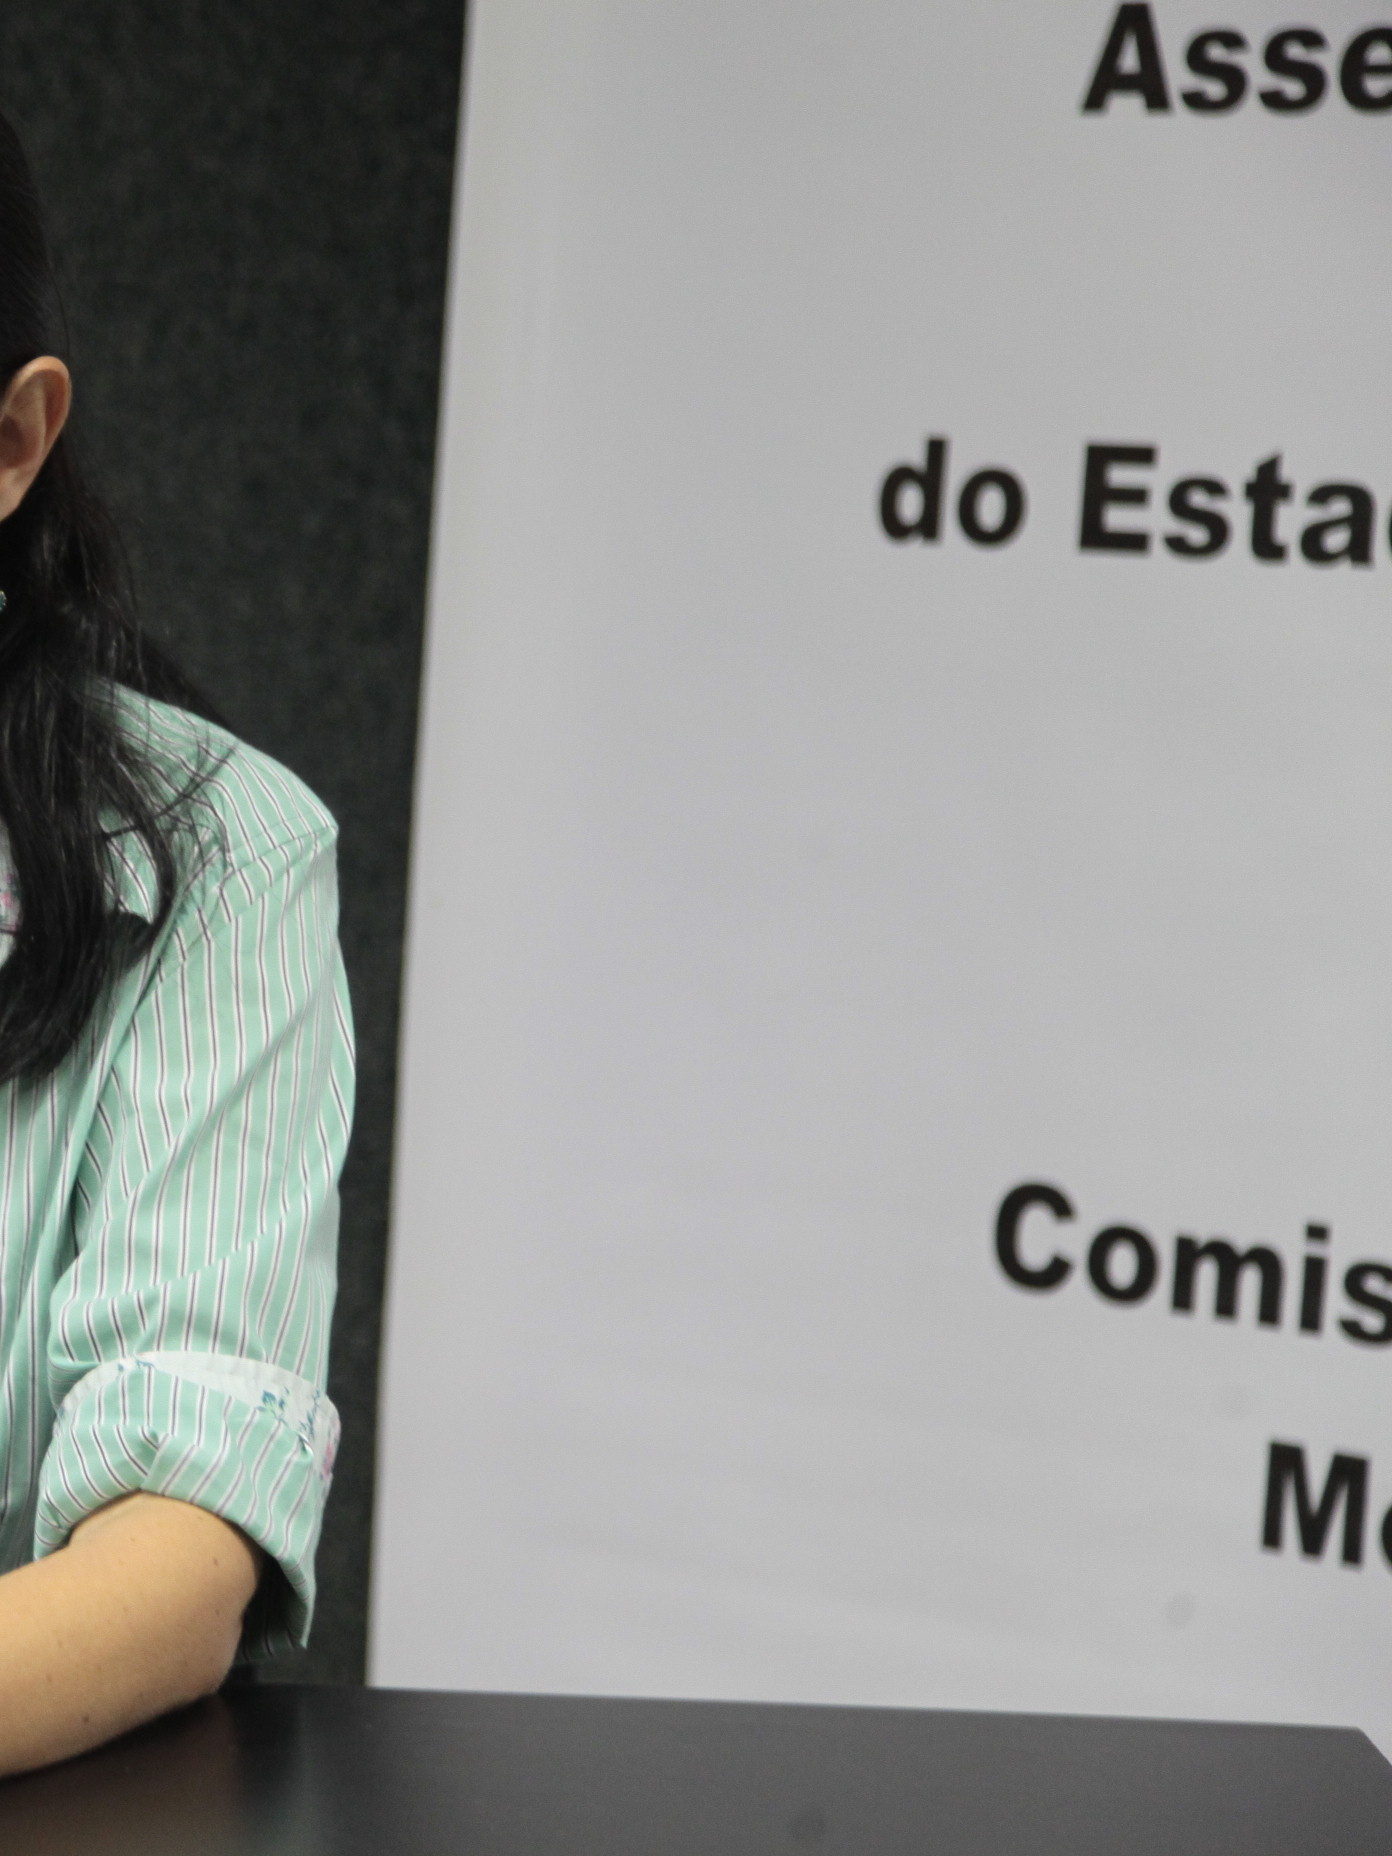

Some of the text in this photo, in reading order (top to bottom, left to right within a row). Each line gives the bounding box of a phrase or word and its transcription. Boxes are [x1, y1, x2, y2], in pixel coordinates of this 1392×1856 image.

[1082, 1, 1392, 115] Asse
[879, 435, 1392, 568] do Esta
[993, 1179, 1392, 1346] Comis
[1261, 1438, 1392, 1574] M
